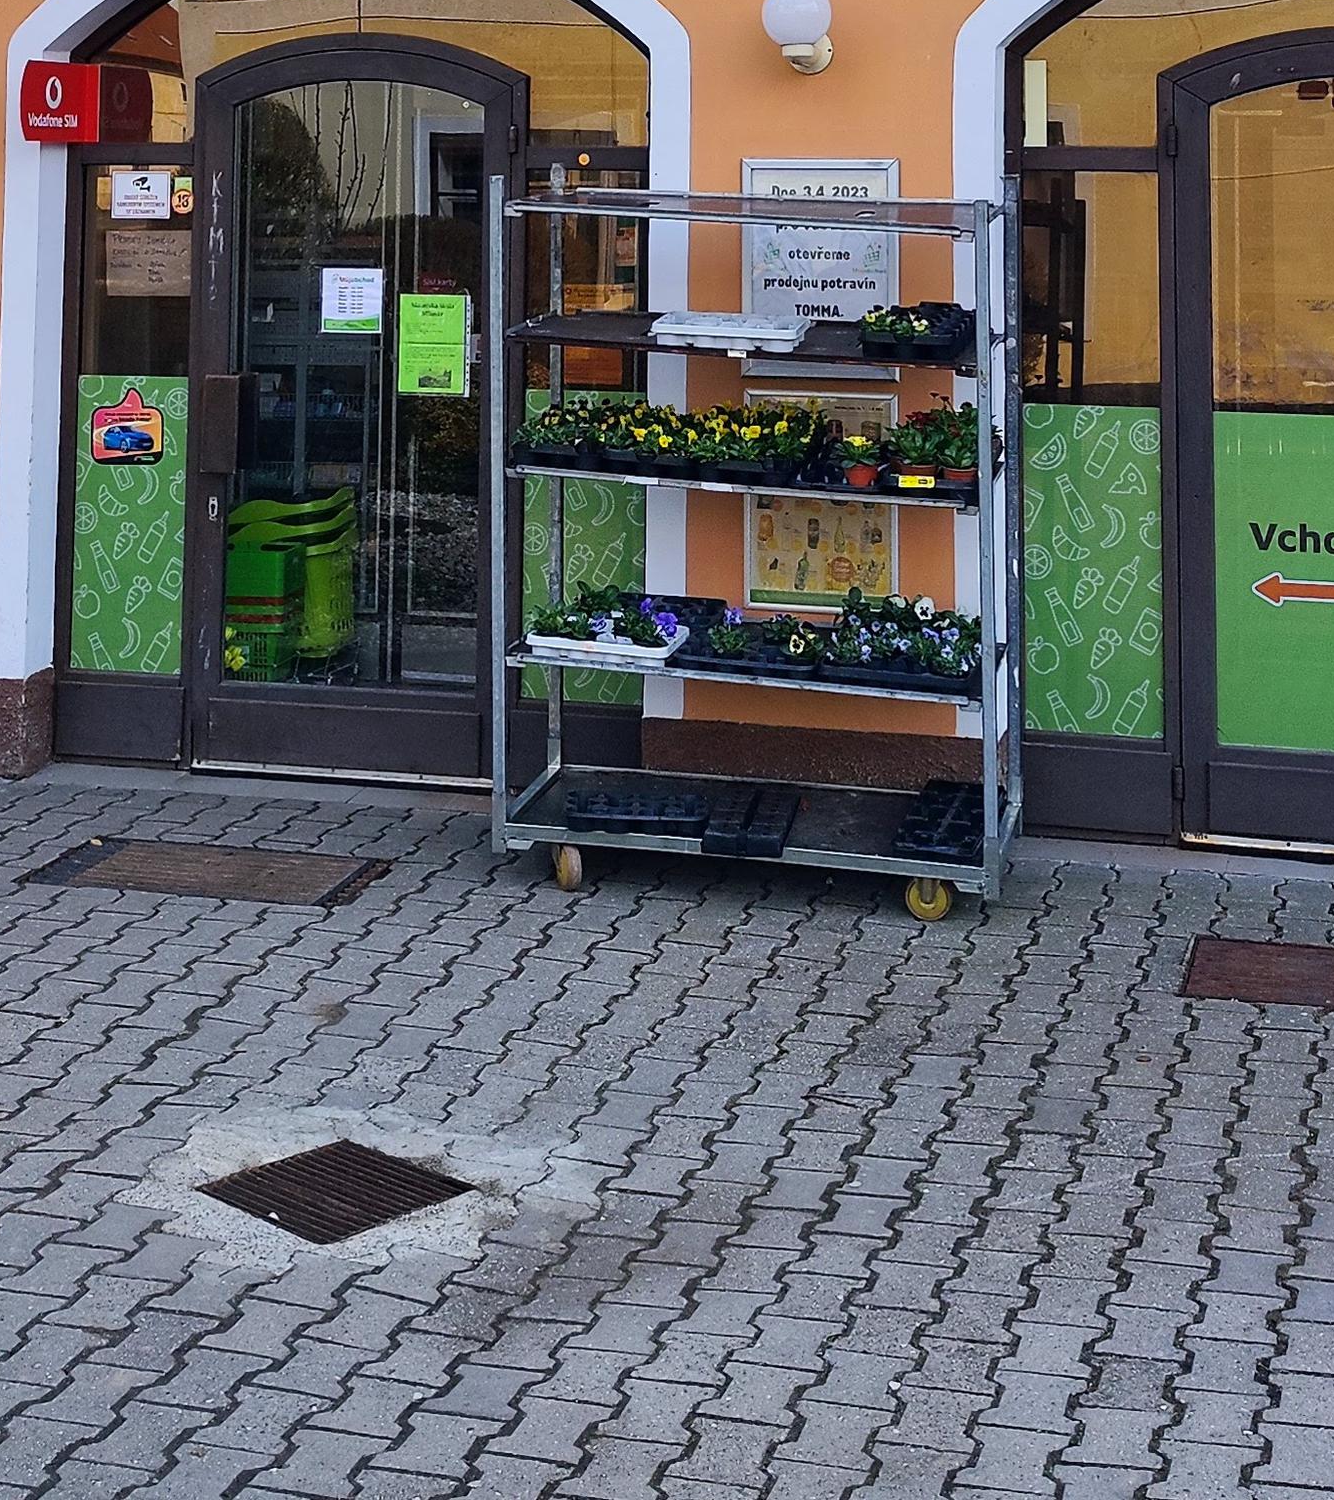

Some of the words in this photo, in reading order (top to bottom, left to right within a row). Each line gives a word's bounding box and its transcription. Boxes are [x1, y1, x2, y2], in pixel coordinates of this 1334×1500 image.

[28, 112, 63, 128] Vodafone
[64, 114, 78, 128] SIM
[831, 186, 870, 199] 2023
[788, 245, 851, 261] otevřeme
[763, 276, 818, 292] prodejnu
[794, 303, 844, 318] TOMMA.
